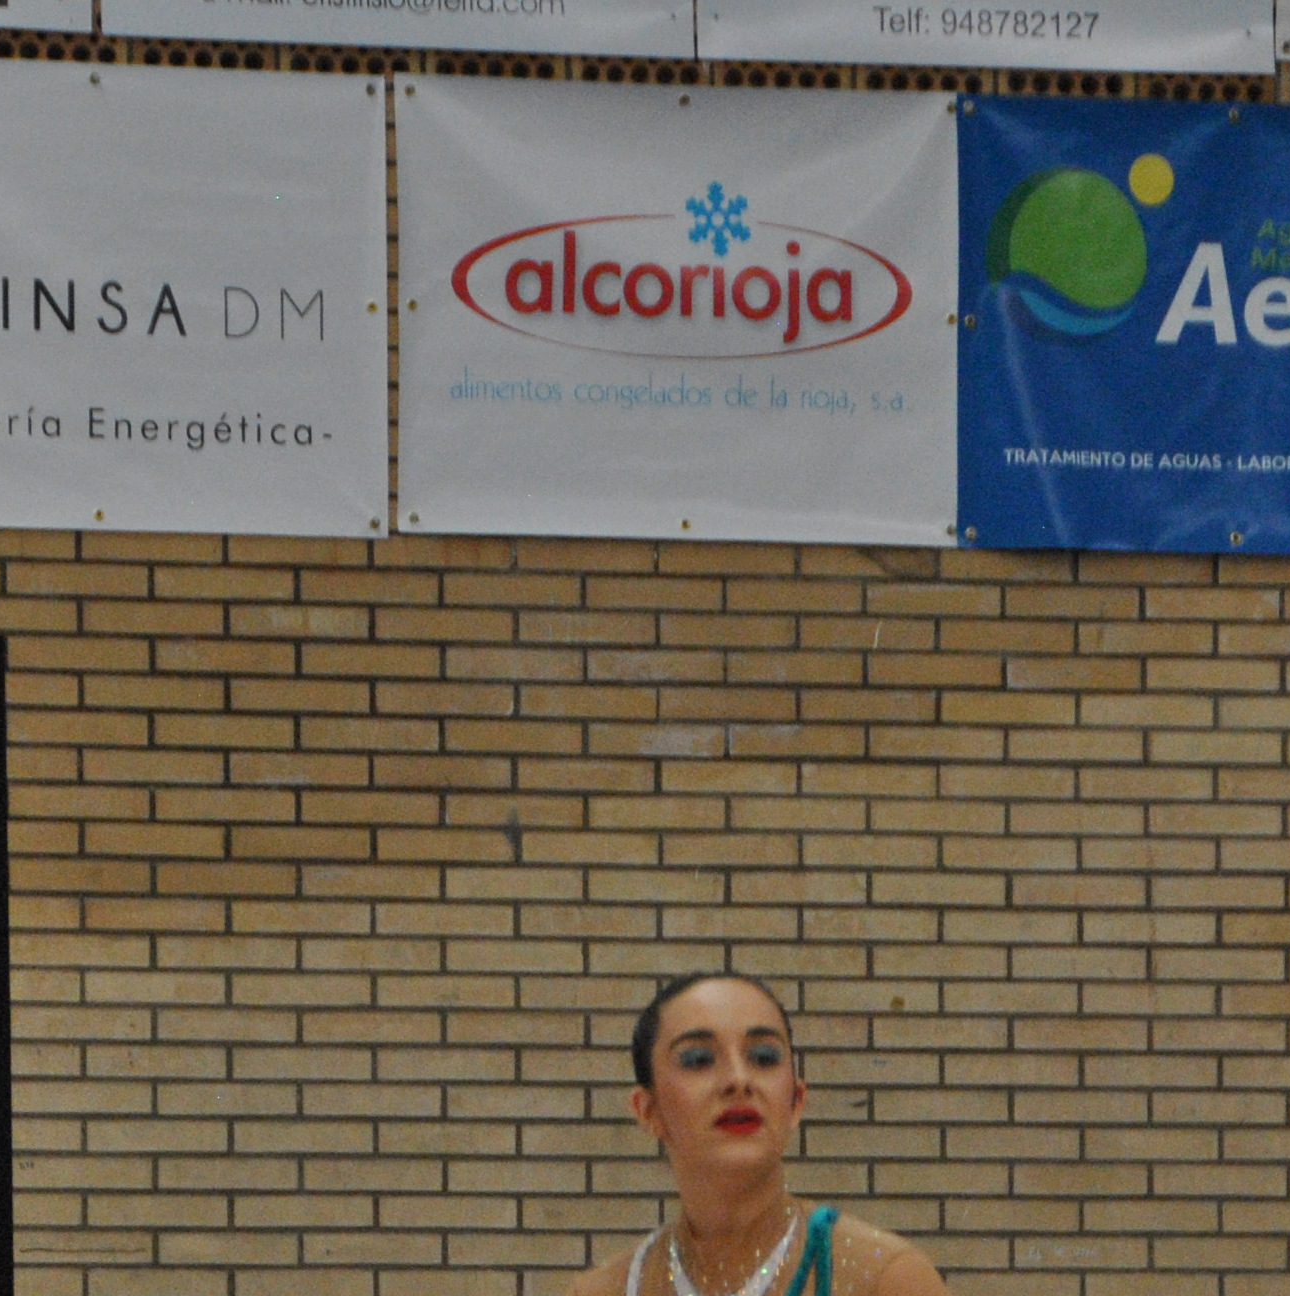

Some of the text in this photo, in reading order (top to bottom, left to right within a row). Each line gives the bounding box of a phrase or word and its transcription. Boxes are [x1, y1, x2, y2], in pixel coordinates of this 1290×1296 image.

[873, 6, 1100, 39] Telf: 948782127
[1, 276, 325, 342] INSA DM
[505, 229, 853, 344] alcorioja
[449, 364, 563, 402] alimentos
[574, 372, 711, 411] congelados
[725, 373, 757, 410] de
[769, 374, 788, 410] la
[871, 389, 910, 413] s.a.
[1004, 448, 1126, 469] TRATAMIENTO
[1130, 452, 1154, 470] DE
[1158, 453, 1222, 470] AGUAS
